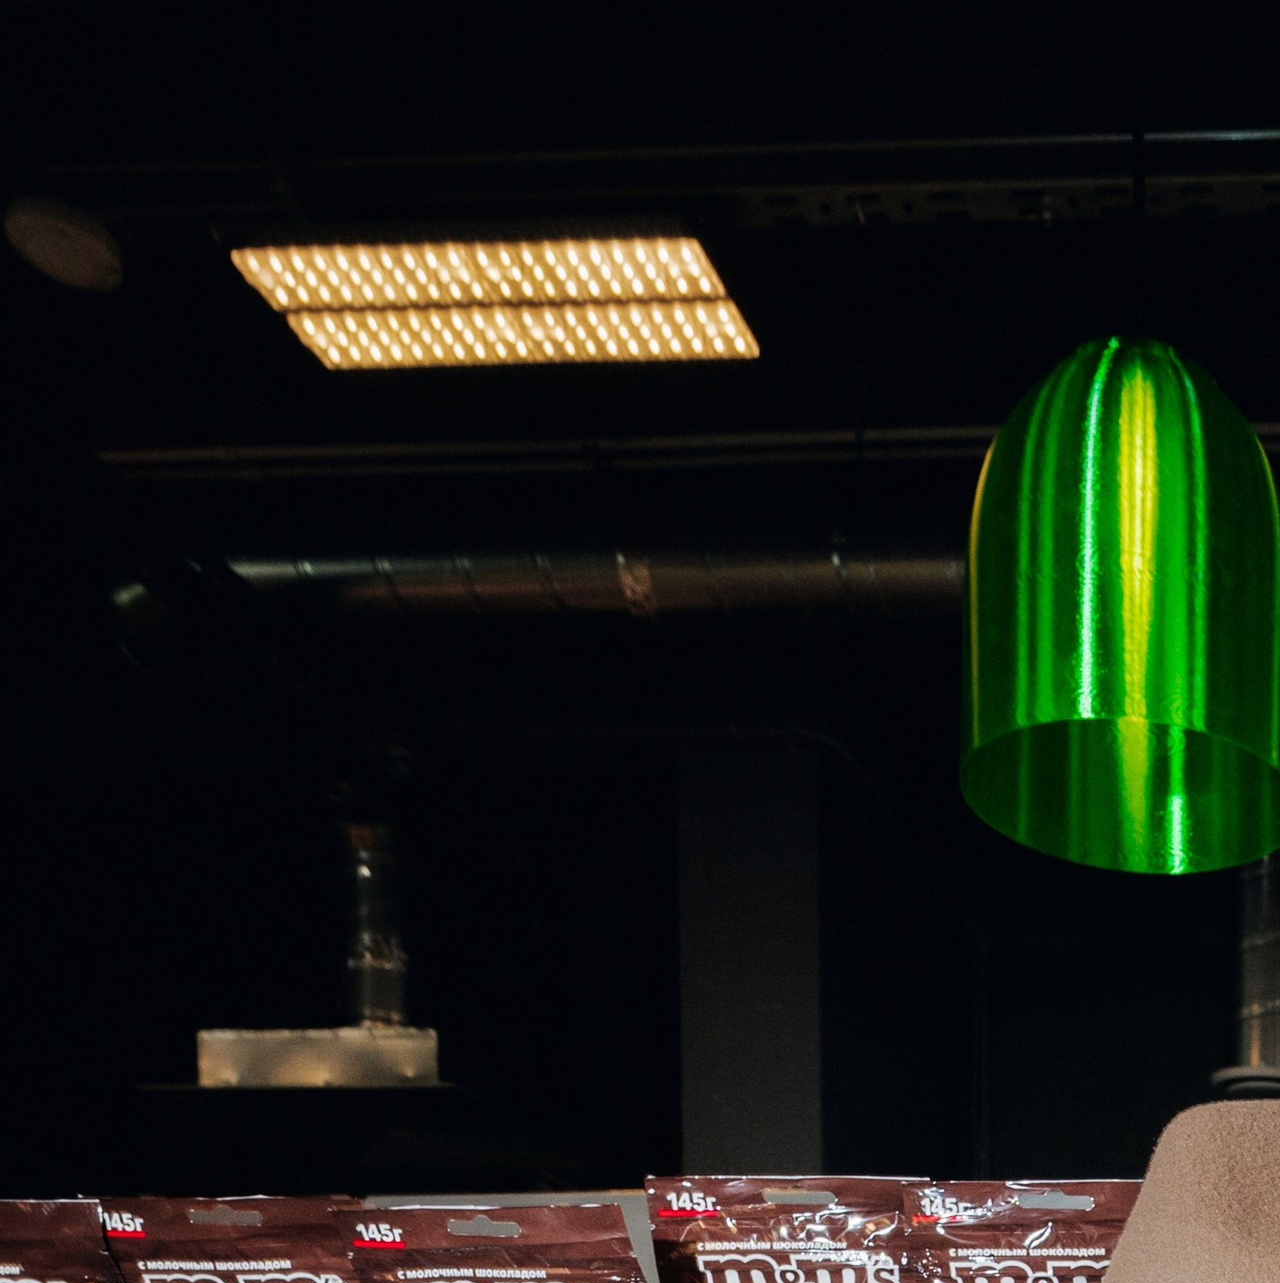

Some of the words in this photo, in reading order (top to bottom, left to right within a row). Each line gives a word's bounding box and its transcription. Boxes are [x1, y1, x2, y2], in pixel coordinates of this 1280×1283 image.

[666, 1192, 717, 1211] 145г
[103, 1212, 144, 1231] 145г
[356, 1223, 403, 1242] 145г
[1029, 1248, 1106, 1257] шоколадом
[147, 1261, 214, 1270] молочным
[216, 1260, 291, 1271] шоколадом
[406, 1268, 474, 1279] молочным
[476, 1268, 547, 1279] шоколадом
